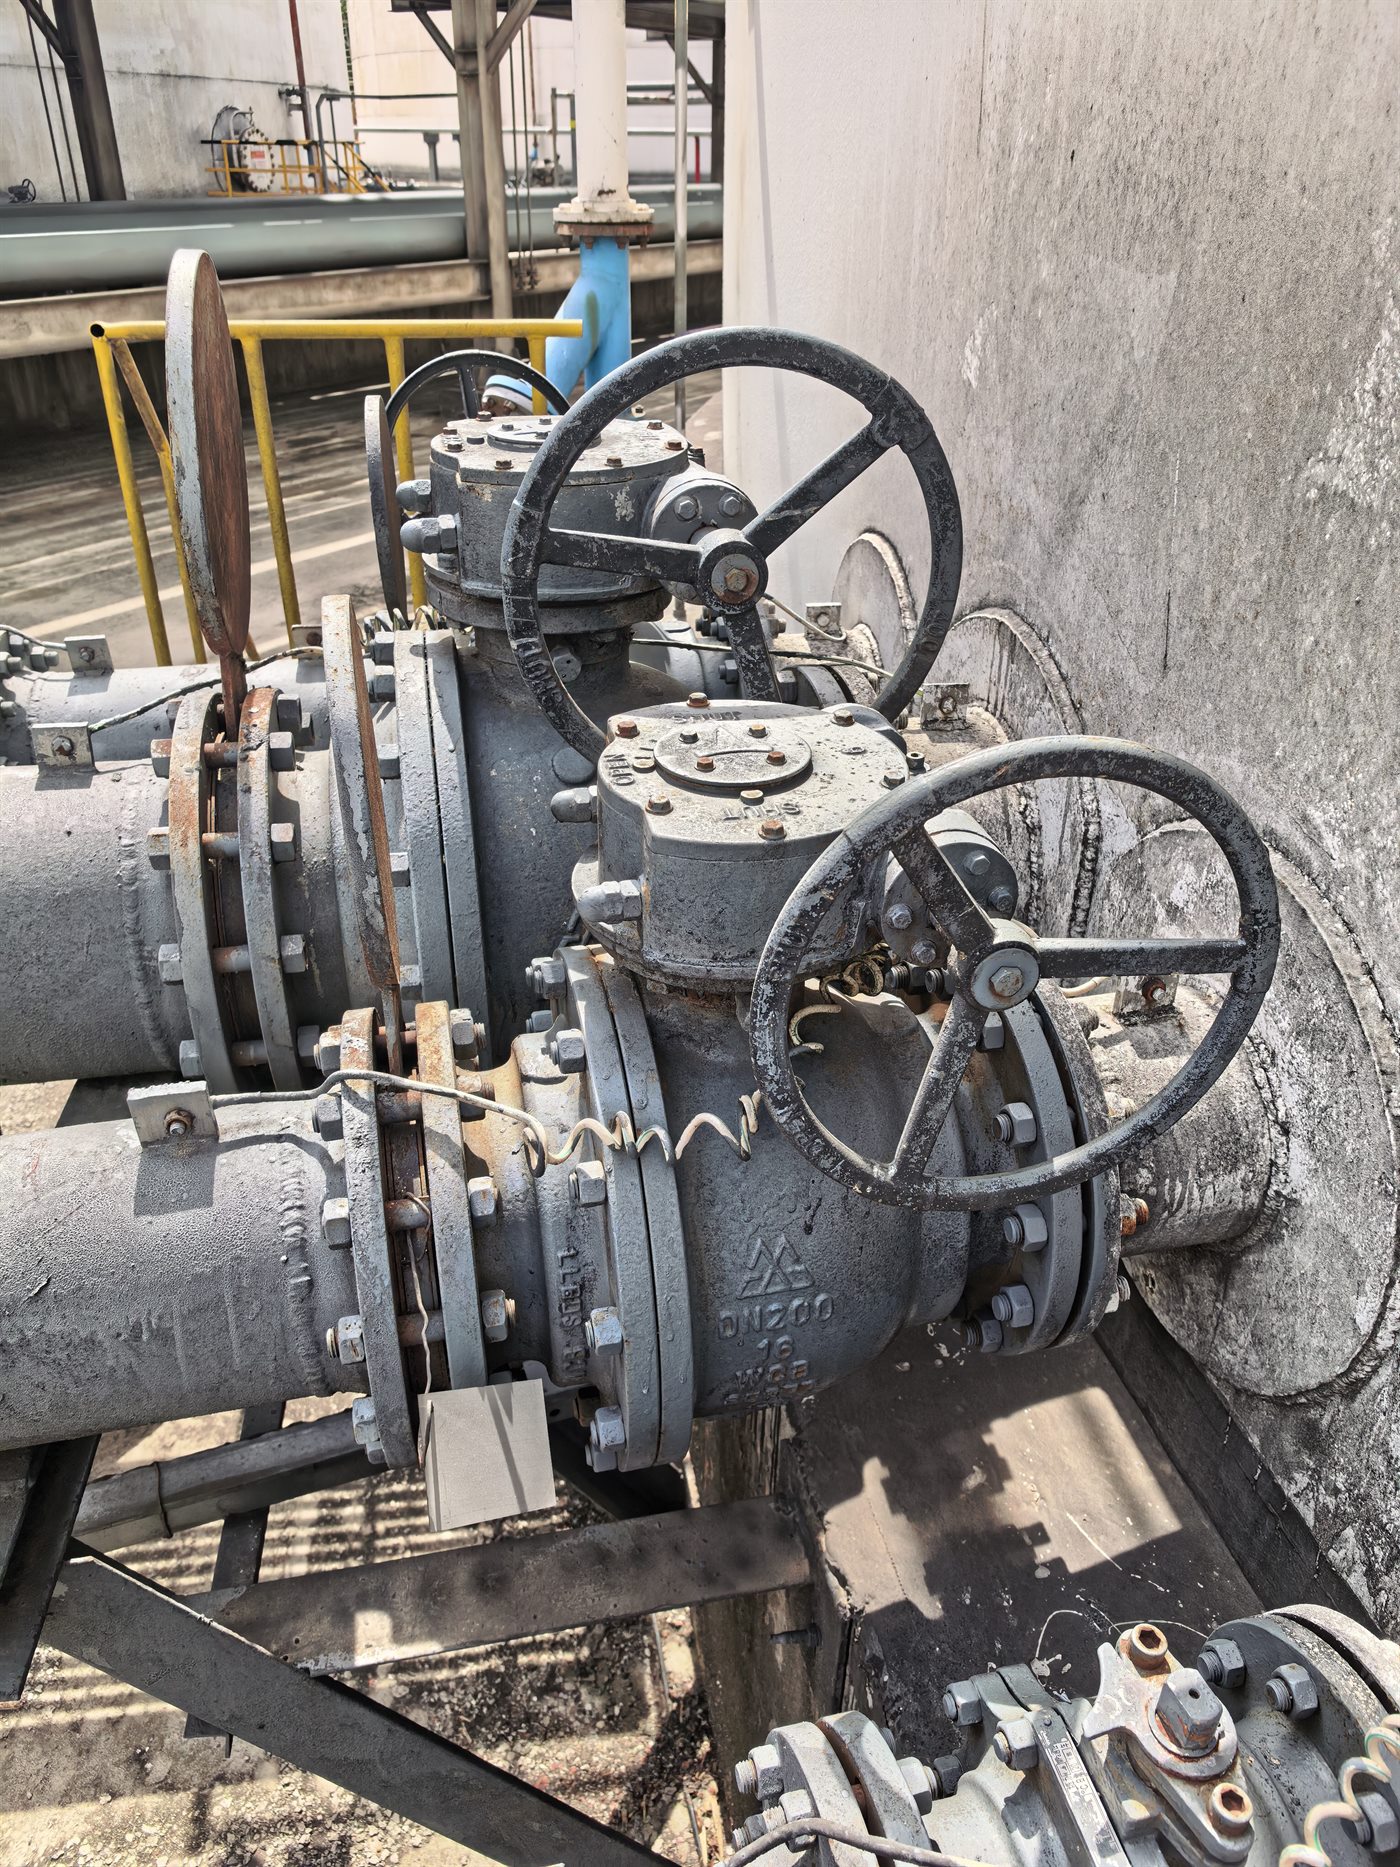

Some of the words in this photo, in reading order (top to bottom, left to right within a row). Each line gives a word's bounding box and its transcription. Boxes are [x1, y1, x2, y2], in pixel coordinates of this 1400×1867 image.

[603, 753, 635, 786] OPEN
[723, 801, 801, 821] SHUT
[718, 1293, 835, 1340] DN200
[756, 1334, 796, 1361] 16
